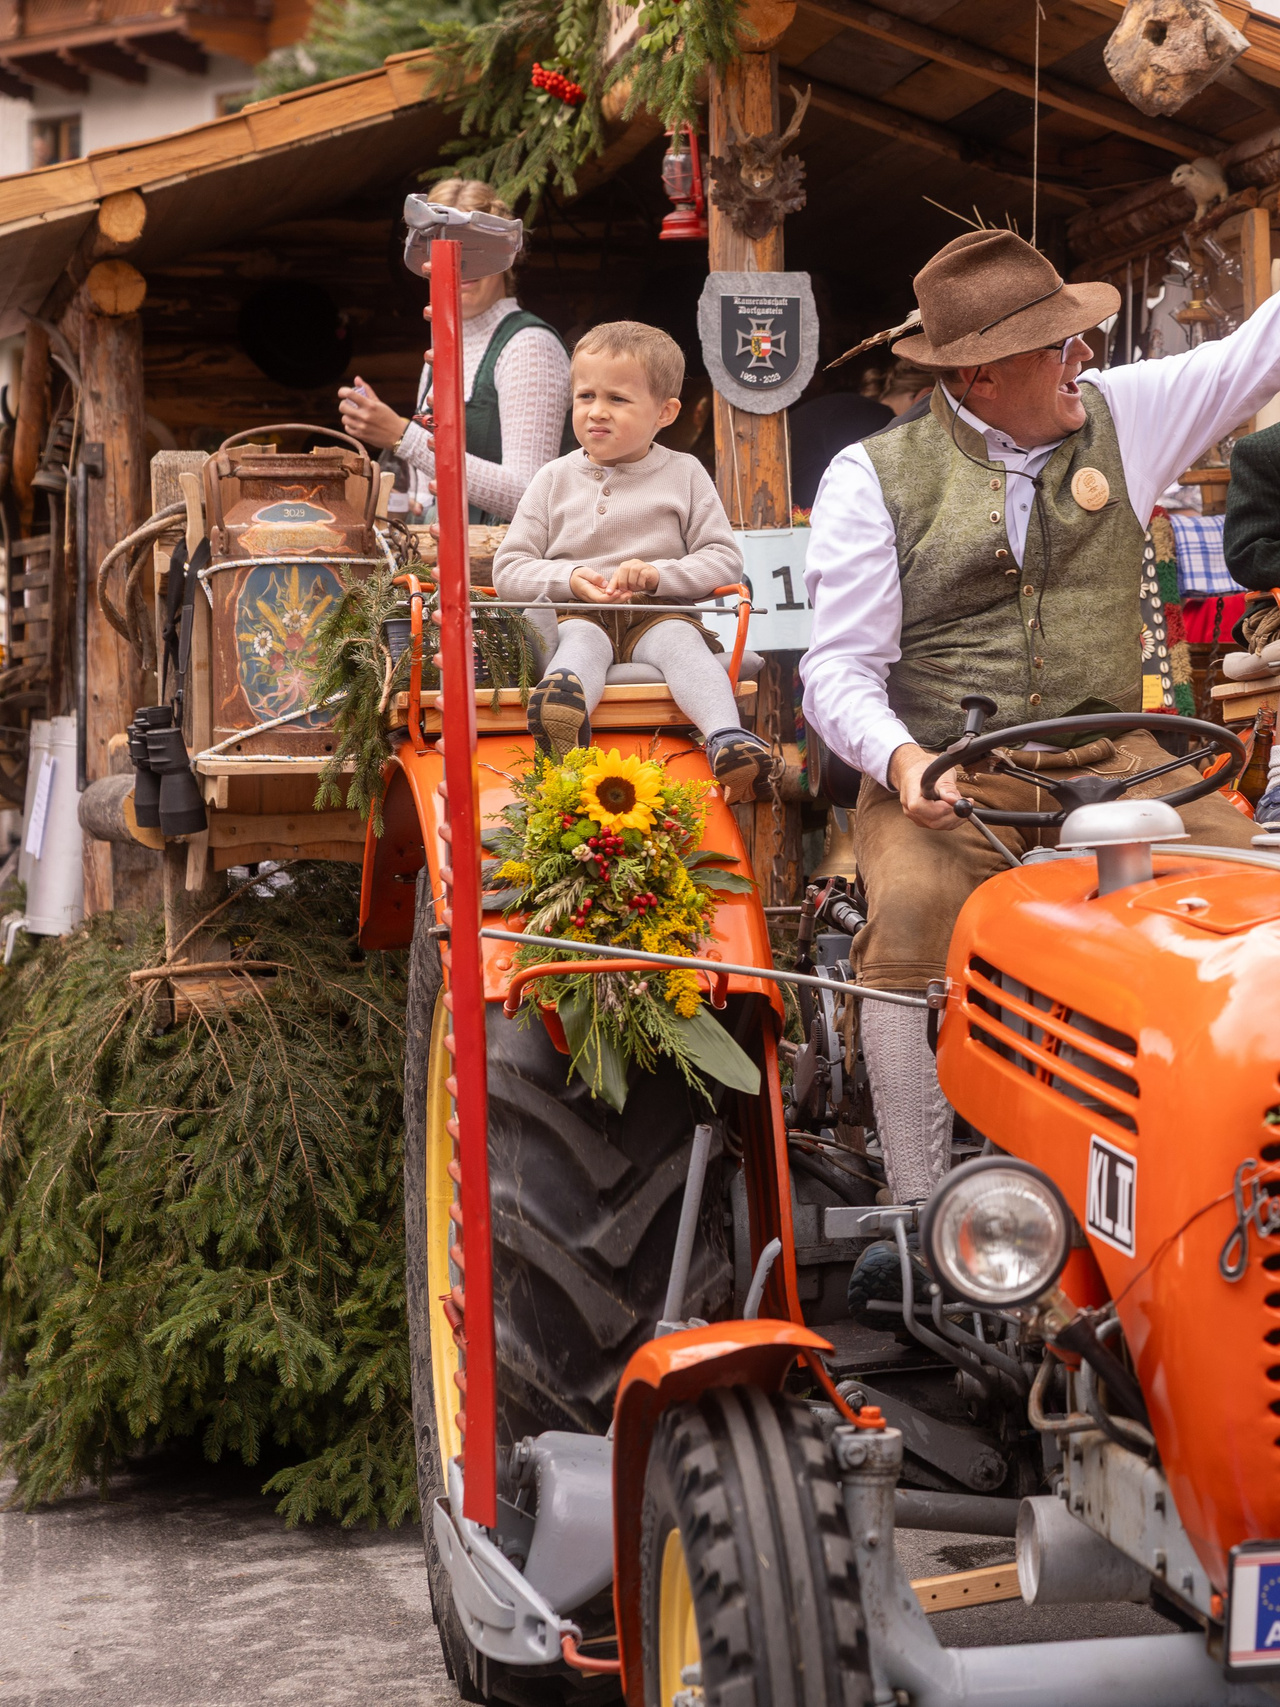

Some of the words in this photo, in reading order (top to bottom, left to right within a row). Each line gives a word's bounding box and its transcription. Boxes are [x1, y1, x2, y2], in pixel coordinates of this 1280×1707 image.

[733, 296, 789, 307] Kameradschaft
[738, 306, 784, 316] Dorfgastein
[740, 371, 758, 383] 1923
[762, 372, 782, 384] 2023
